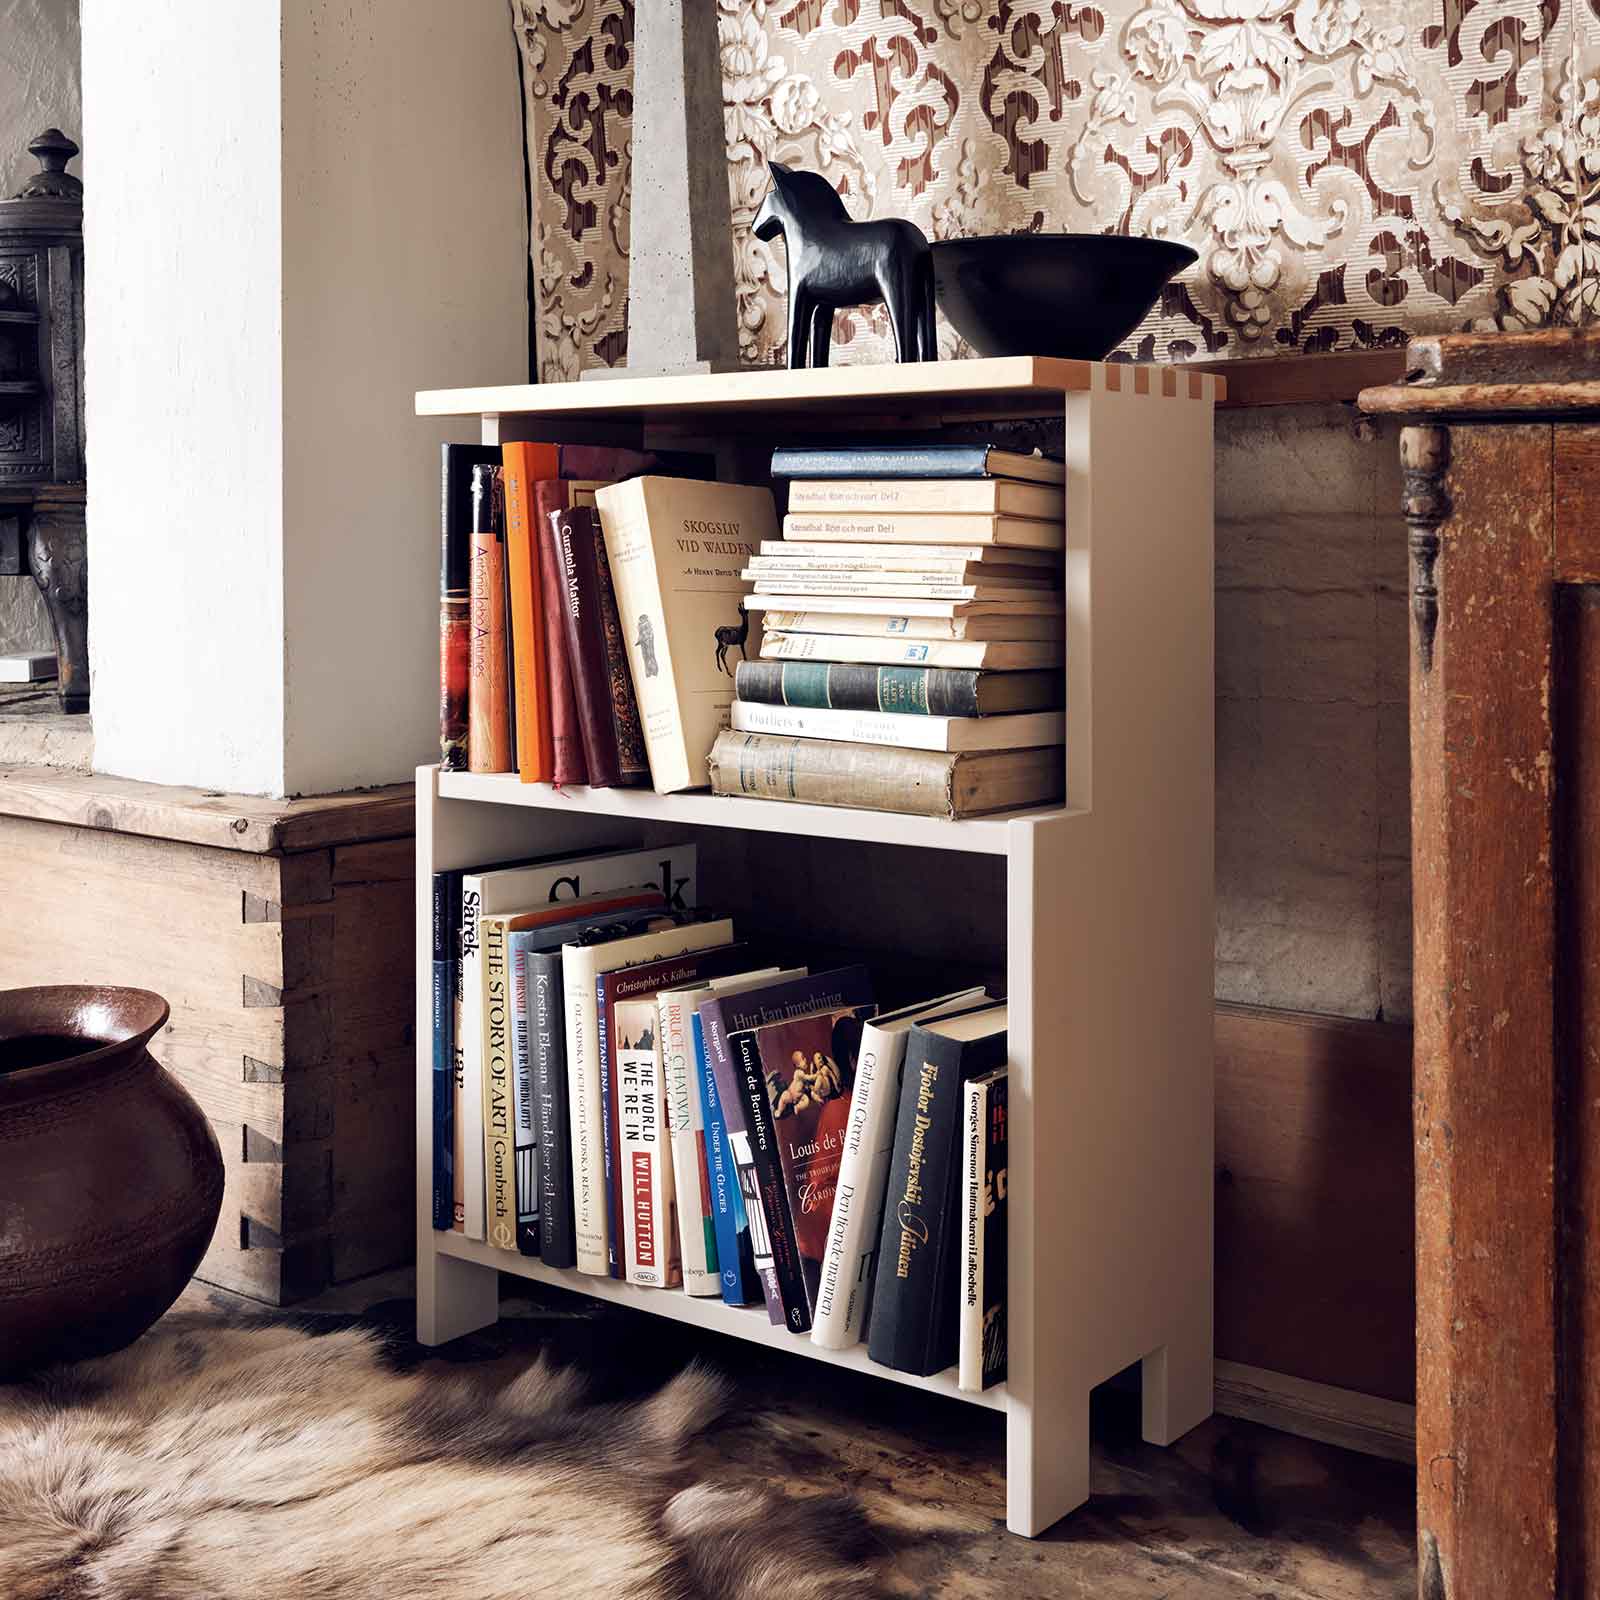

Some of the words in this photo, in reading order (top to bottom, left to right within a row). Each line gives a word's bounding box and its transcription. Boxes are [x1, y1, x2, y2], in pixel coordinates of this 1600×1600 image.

[677, 539, 700, 553] VID
[703, 541, 754, 557] WALDEN
[682, 519, 741, 536] SKOGSLIV
[561, 524, 577, 576] Curatola
[569, 576, 581, 618] Mattor
[749, 711, 793, 729] Outliers
[463, 890, 481, 958] Sarek
[488, 927, 503, 976] THE
[535, 974, 549, 1026] Kerstin
[596, 988, 605, 1003] DE
[616, 975, 660, 993] Christopher
[489, 981, 505, 1054] STORY
[668, 1004, 684, 1052] BRUCE
[733, 1012, 760, 1030] Hur
[760, 1006, 784, 1024] kan
[785, 991, 843, 1017] inredning
[517, 1020, 528, 1051] BILDER
[538, 1031, 552, 1084] Ekman
[598, 1017, 609, 1093] TIBETANERNA
[710, 1021, 726, 1063] Norrgavel
[739, 1039, 754, 1073] Louis
[491, 1056, 506, 1088] OF
[623, 1061, 639, 1115] WE'RE
[639, 1062, 653, 1086] THE
[672, 1055, 690, 1131] CHATWIN
[705, 1070, 717, 1108] LAXNESS
[746, 1075, 758, 1091] de
[857, 1052, 877, 1105] Graham
[917, 1061, 939, 1113] Fjodor
[491, 1088, 508, 1133] ART
[519, 1077, 532, 1130] JORDKLOTET
[641, 1093, 656, 1142] WORLD
[750, 1094, 767, 1151] Bernières
[968, 1091, 981, 1133] Georges
[541, 1093, 555, 1170] Händelser
[625, 1123, 640, 1141] IN
[710, 1121, 721, 1155] UNDER
[789, 1140, 820, 1160] Louis
[823, 1132, 838, 1151] de
[848, 1108, 868, 1156] Greene
[493, 1140, 509, 1218] Gombrich
[635, 1157, 650, 1194] WILL
[713, 1155, 722, 1173] THE
[903, 1113, 932, 1206] Dostojevskij
[968, 1134, 980, 1179] Simenon
[543, 1173, 556, 1197] vid
[581, 1176, 590, 1203] RESA
[716, 1173, 727, 1214] GLACIER
[838, 1184, 855, 1210] Den
[636, 1201, 652, 1261] HUTTON
[968, 1181, 979, 1246] Hattmakaren
[830, 1216, 848, 1259] tionde
[897, 1200, 929, 1279] Idioten
[821, 1260, 839, 1316] mannen
